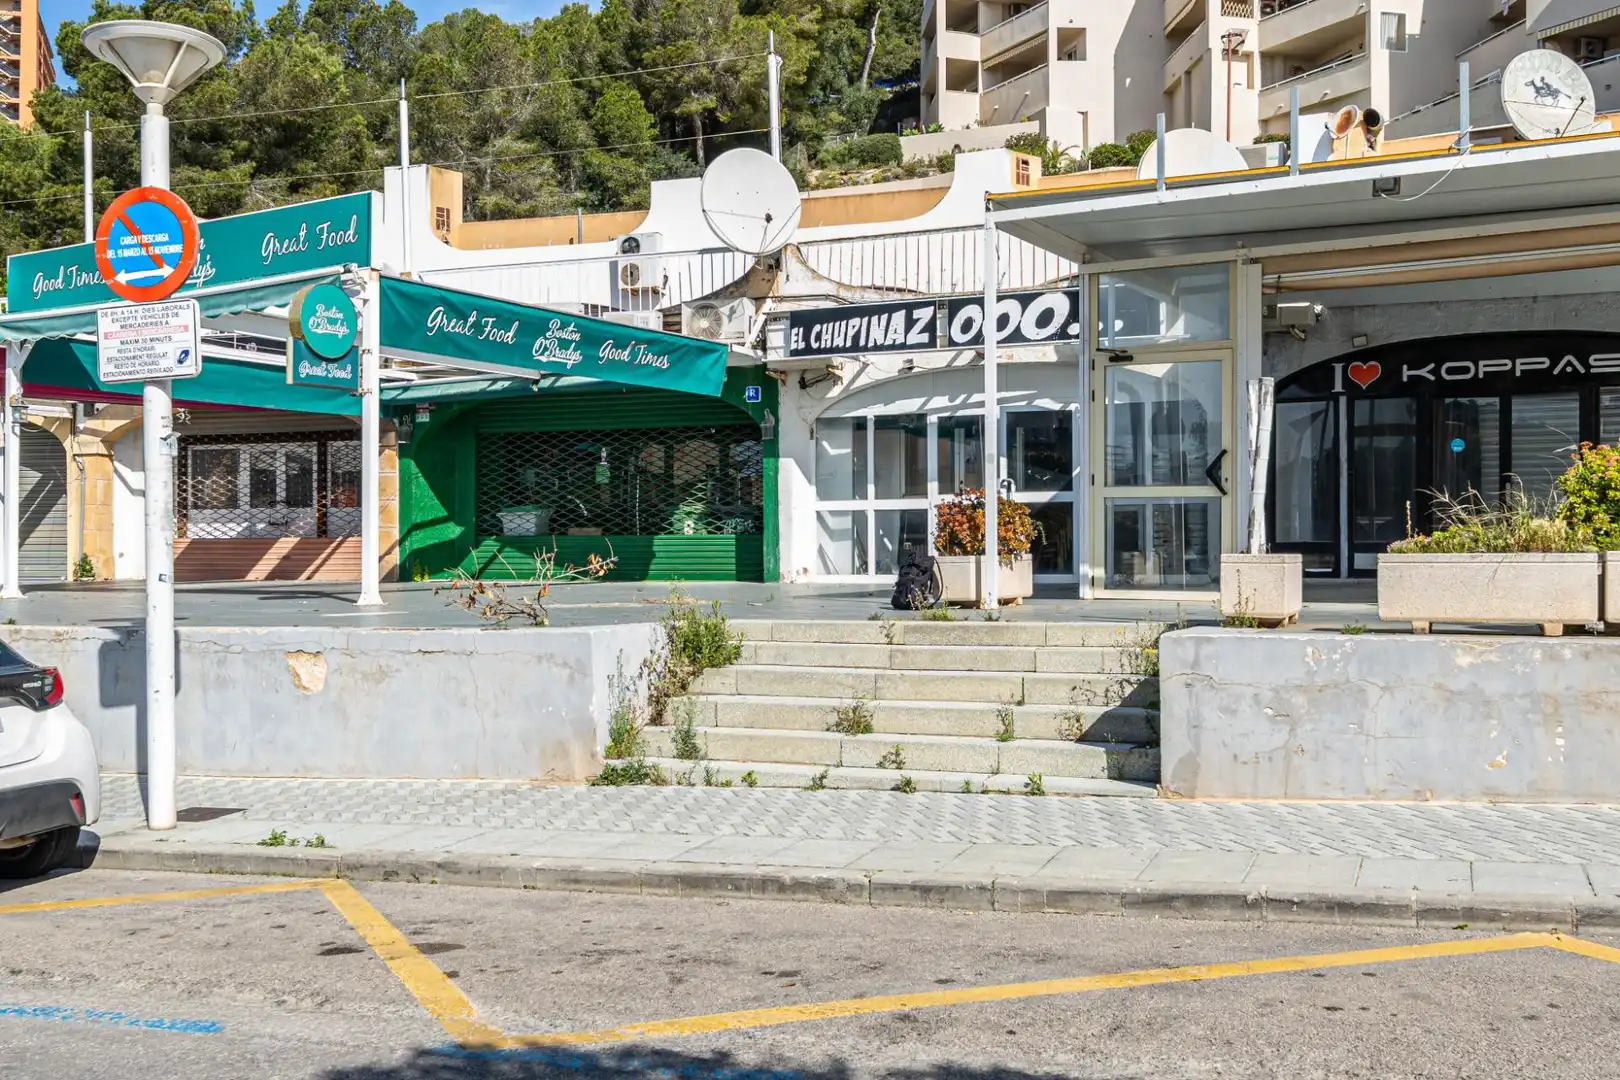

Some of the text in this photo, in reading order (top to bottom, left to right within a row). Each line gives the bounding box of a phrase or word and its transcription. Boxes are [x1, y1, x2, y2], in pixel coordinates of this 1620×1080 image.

[120, 235, 137, 246] CARGA
[142, 232, 169, 244] DESCARGA
[261, 214, 359, 265] Great Food
[106, 249, 116, 259] DEL
[33, 265, 65, 300] Good
[111, 315, 139, 323] EXCEPTE
[140, 312, 170, 321] VEHICLES
[157, 303, 191, 312] LABORALS
[315, 303, 344, 319] Boston
[119, 320, 164, 330] MERCADERIES
[308, 315, 350, 339] O'Brady's
[427, 306, 520, 345] Great Food
[546, 318, 582, 342] Boston
[790, 327, 806, 350] EL
[810, 305, 935, 349] CHUPINAZ
[149, 335, 172, 343] MINUTS
[598, 339, 670, 369] Good Times
[299, 360, 352, 380] Great Food
[1331, 353, 1620, 393] I KOPPAS
